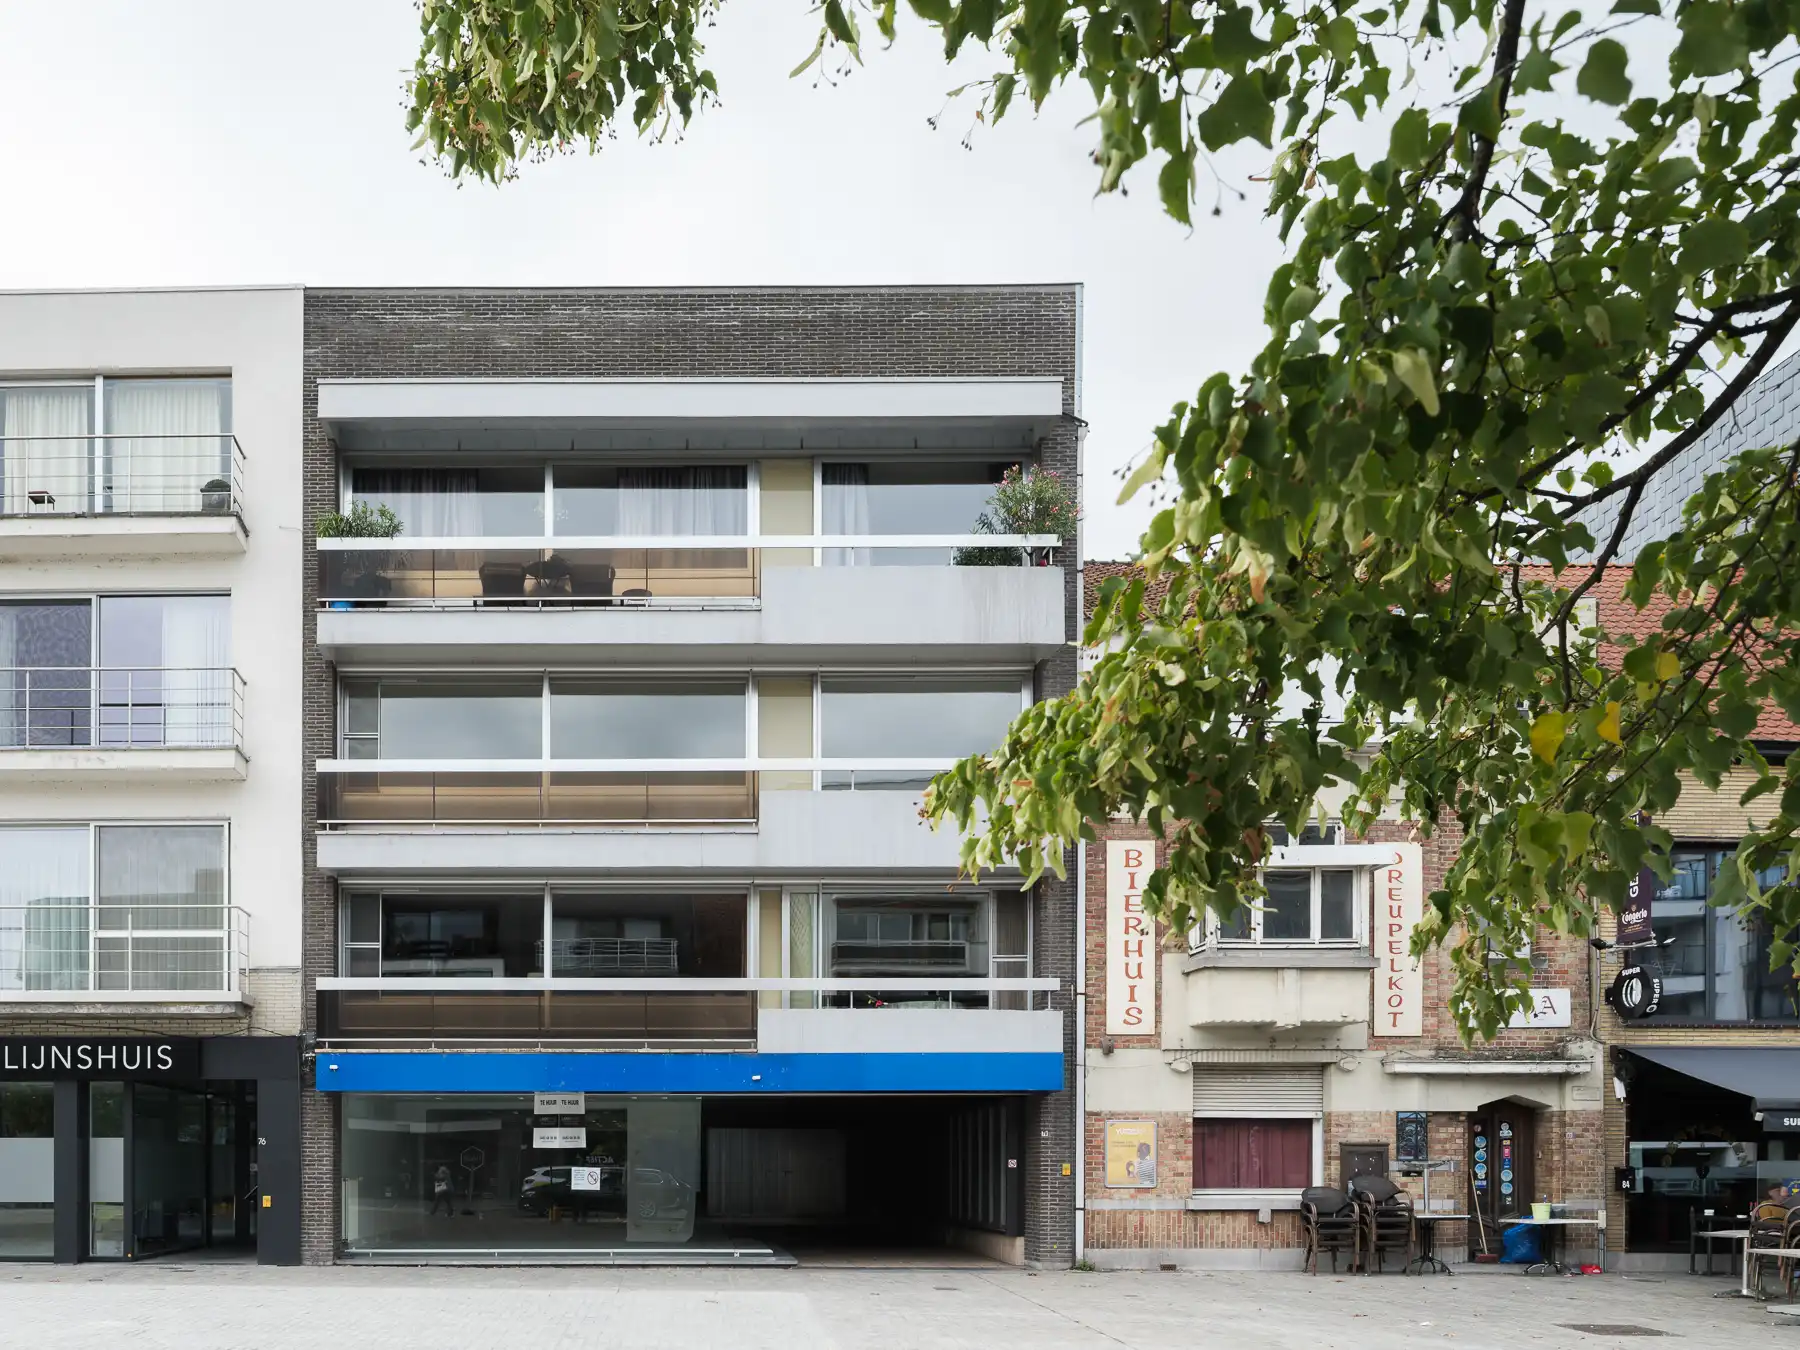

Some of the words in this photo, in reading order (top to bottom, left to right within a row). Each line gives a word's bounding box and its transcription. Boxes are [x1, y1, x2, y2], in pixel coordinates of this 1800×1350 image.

[1122, 848, 1144, 1026] BIERHUIS
[1621, 966, 1641, 977] SUPER
[1651, 978, 1661, 1004] SUPER
[4, 1045, 173, 1070] LIJNSHUIS
[258, 1137, 266, 1145] 76
[1622, 1180, 1630, 1188] 84
